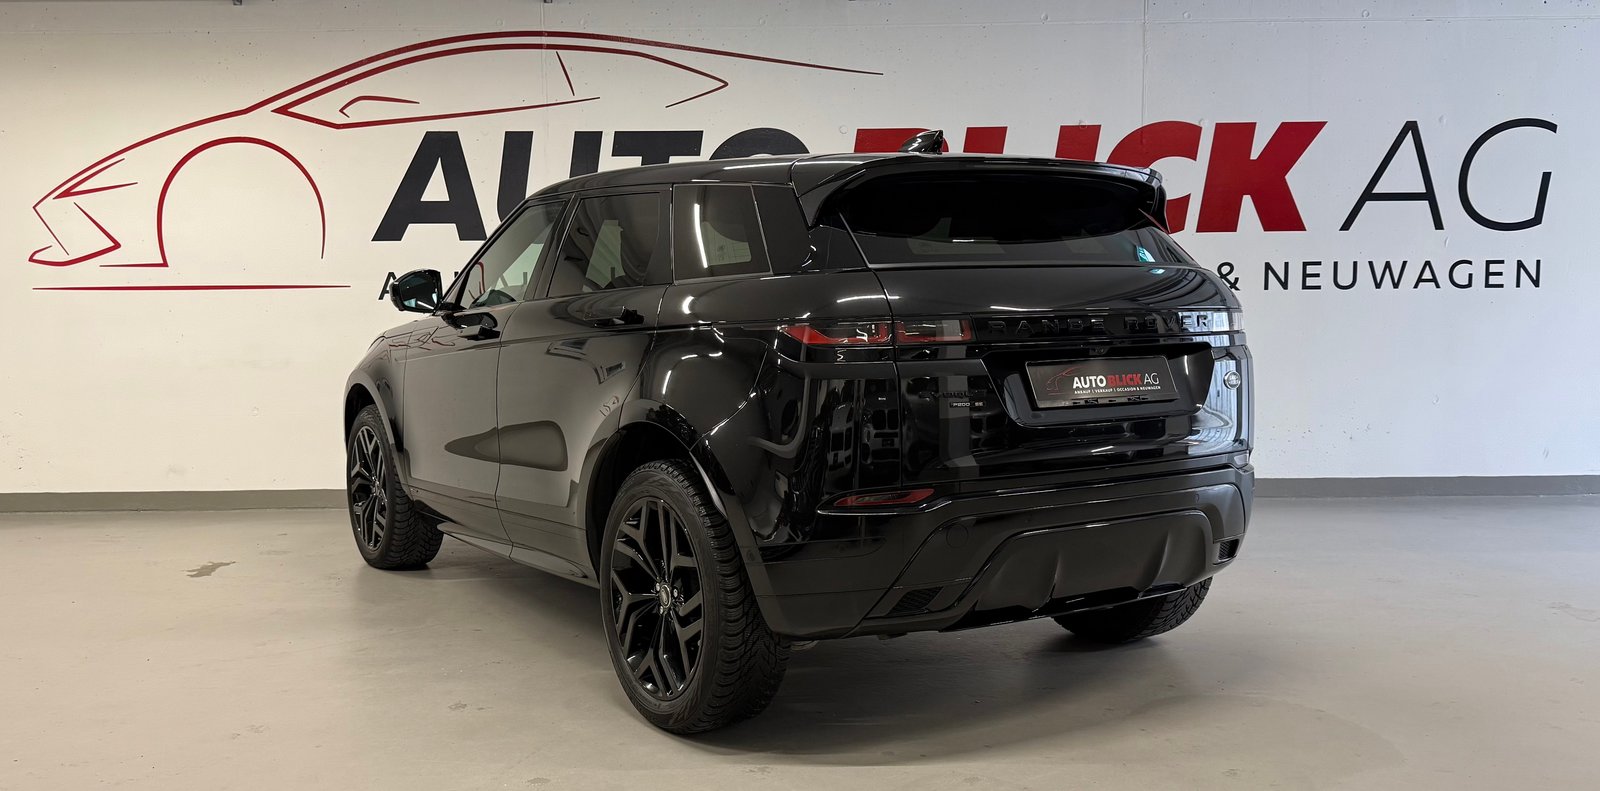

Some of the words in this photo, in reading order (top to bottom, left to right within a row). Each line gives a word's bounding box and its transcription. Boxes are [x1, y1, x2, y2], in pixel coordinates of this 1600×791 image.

[1340, 118, 1558, 232] AG
[1216, 261, 1240, 291] &
[1263, 259, 1541, 290] NEUWAGEN
[1072, 375, 1107, 389] AUTO
[1107, 374, 1142, 387] BLICK
[1144, 373, 1159, 385] AG
